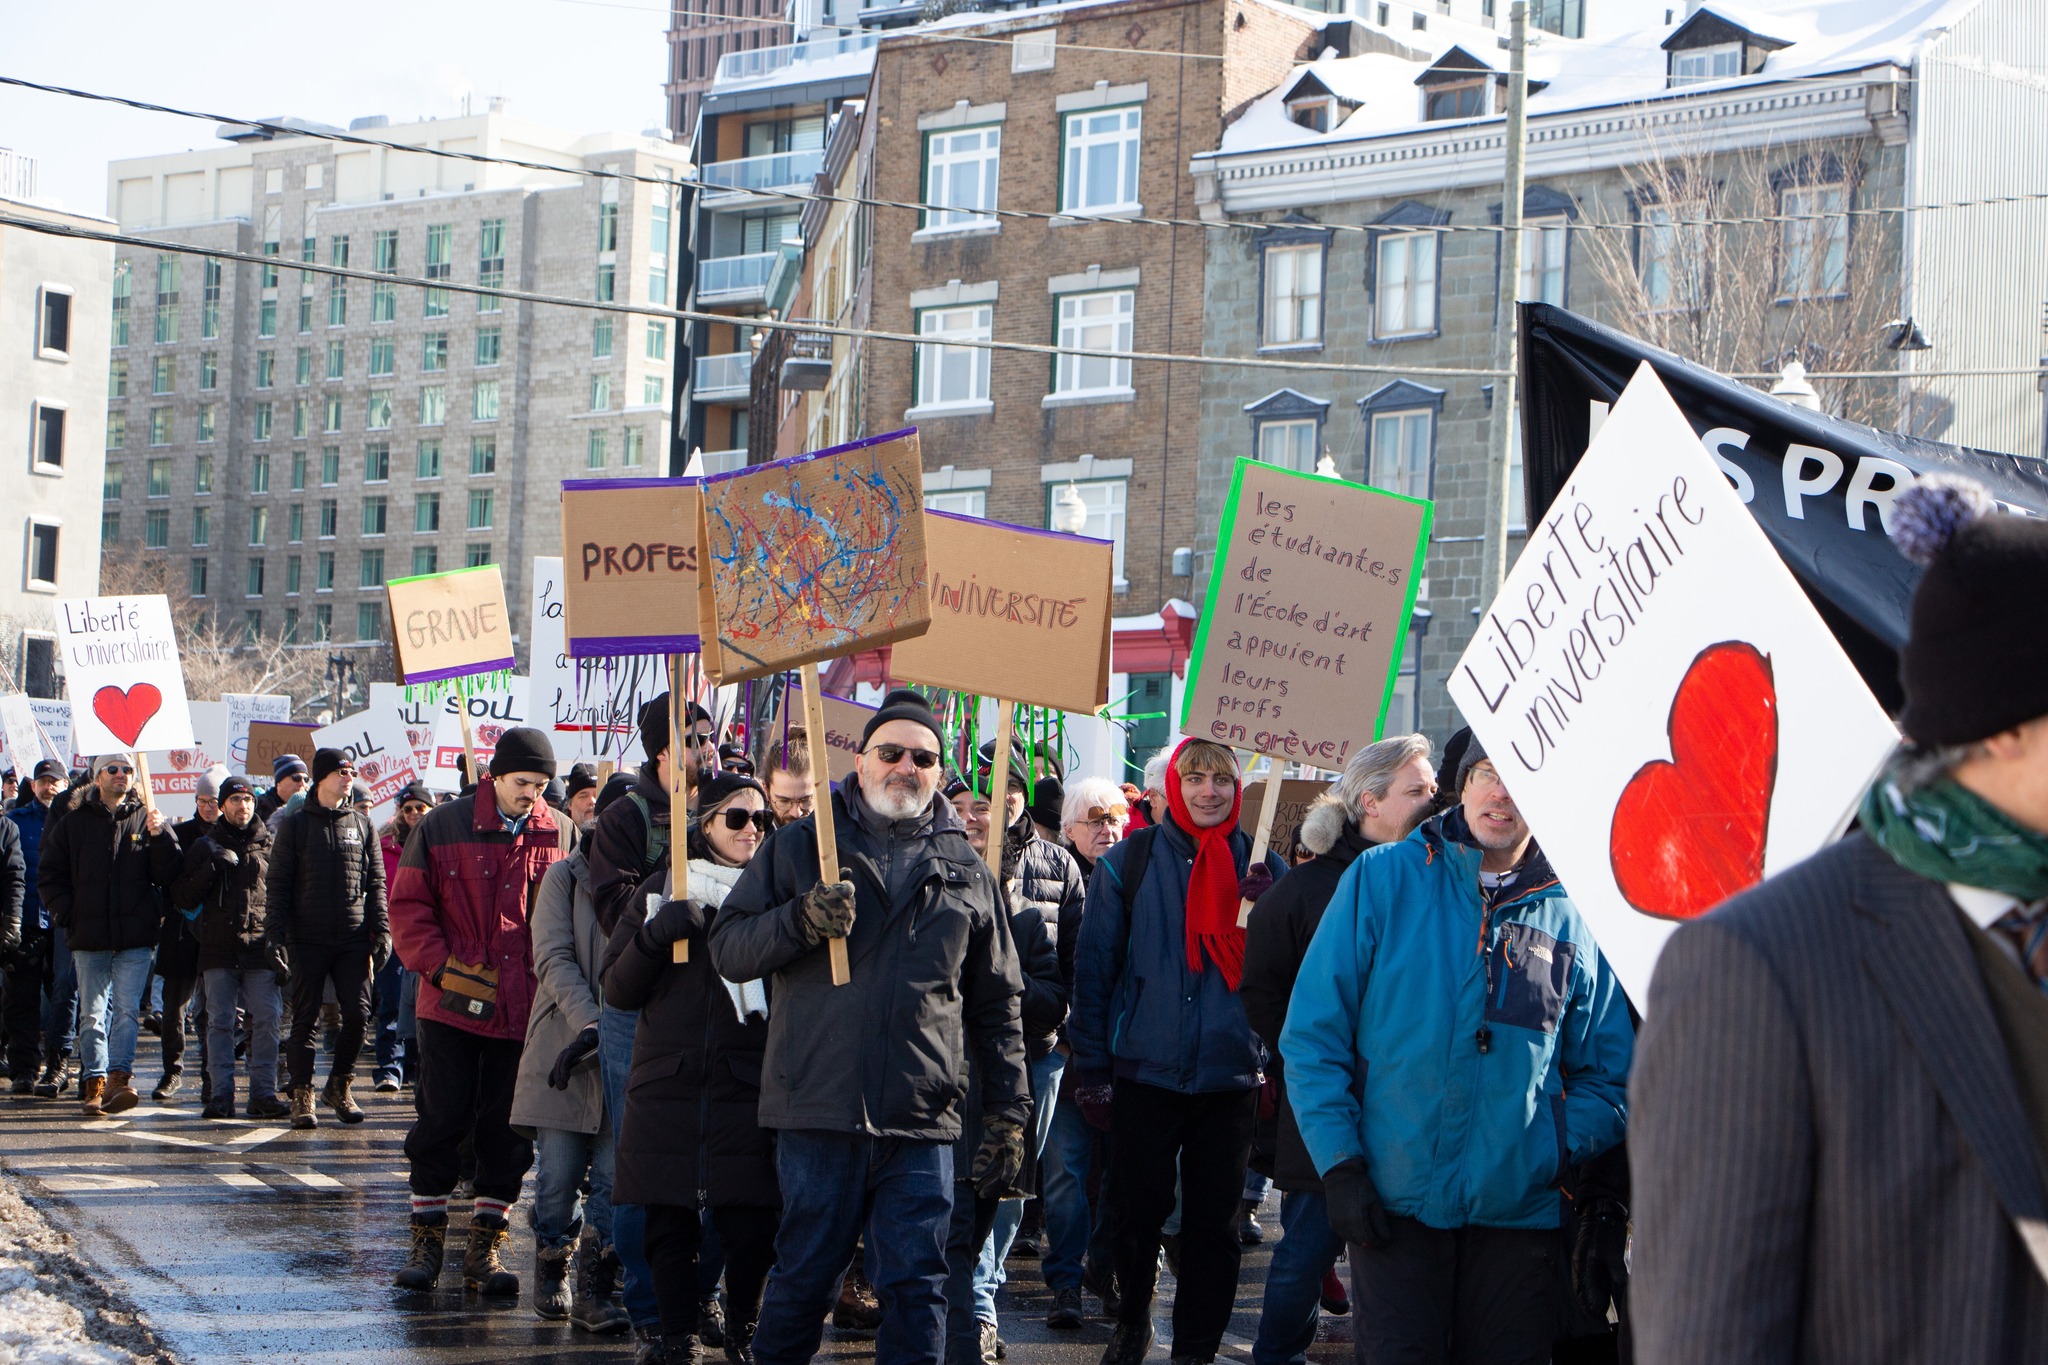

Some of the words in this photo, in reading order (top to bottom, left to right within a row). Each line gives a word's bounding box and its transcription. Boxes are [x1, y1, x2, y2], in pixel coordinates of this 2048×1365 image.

[1782, 443, 1914, 535] PR
[1257, 492, 1296, 522] les
[582, 541, 697, 582] PROFES
[1240, 557, 1272, 582] de
[539, 580, 565, 618] la
[1464, 485, 1604, 714] Liberté
[64, 600, 140, 635] Liberté
[406, 602, 497, 649] GRAVE
[1313, 611, 1372, 642] d'art
[1227, 631, 1346, 675] appuient
[1222, 662, 1289, 697] leurs
[227, 695, 246, 711] Pas
[251, 696, 275, 713] facile
[276, 700, 287, 714] de
[1216, 695, 1282, 719] profs
[824, 729, 863, 754] ÉGIA
[1211, 720, 1247, 741] en
[1255, 729, 1350, 765] grève!
[169, 774, 198, 791] GRÈ
